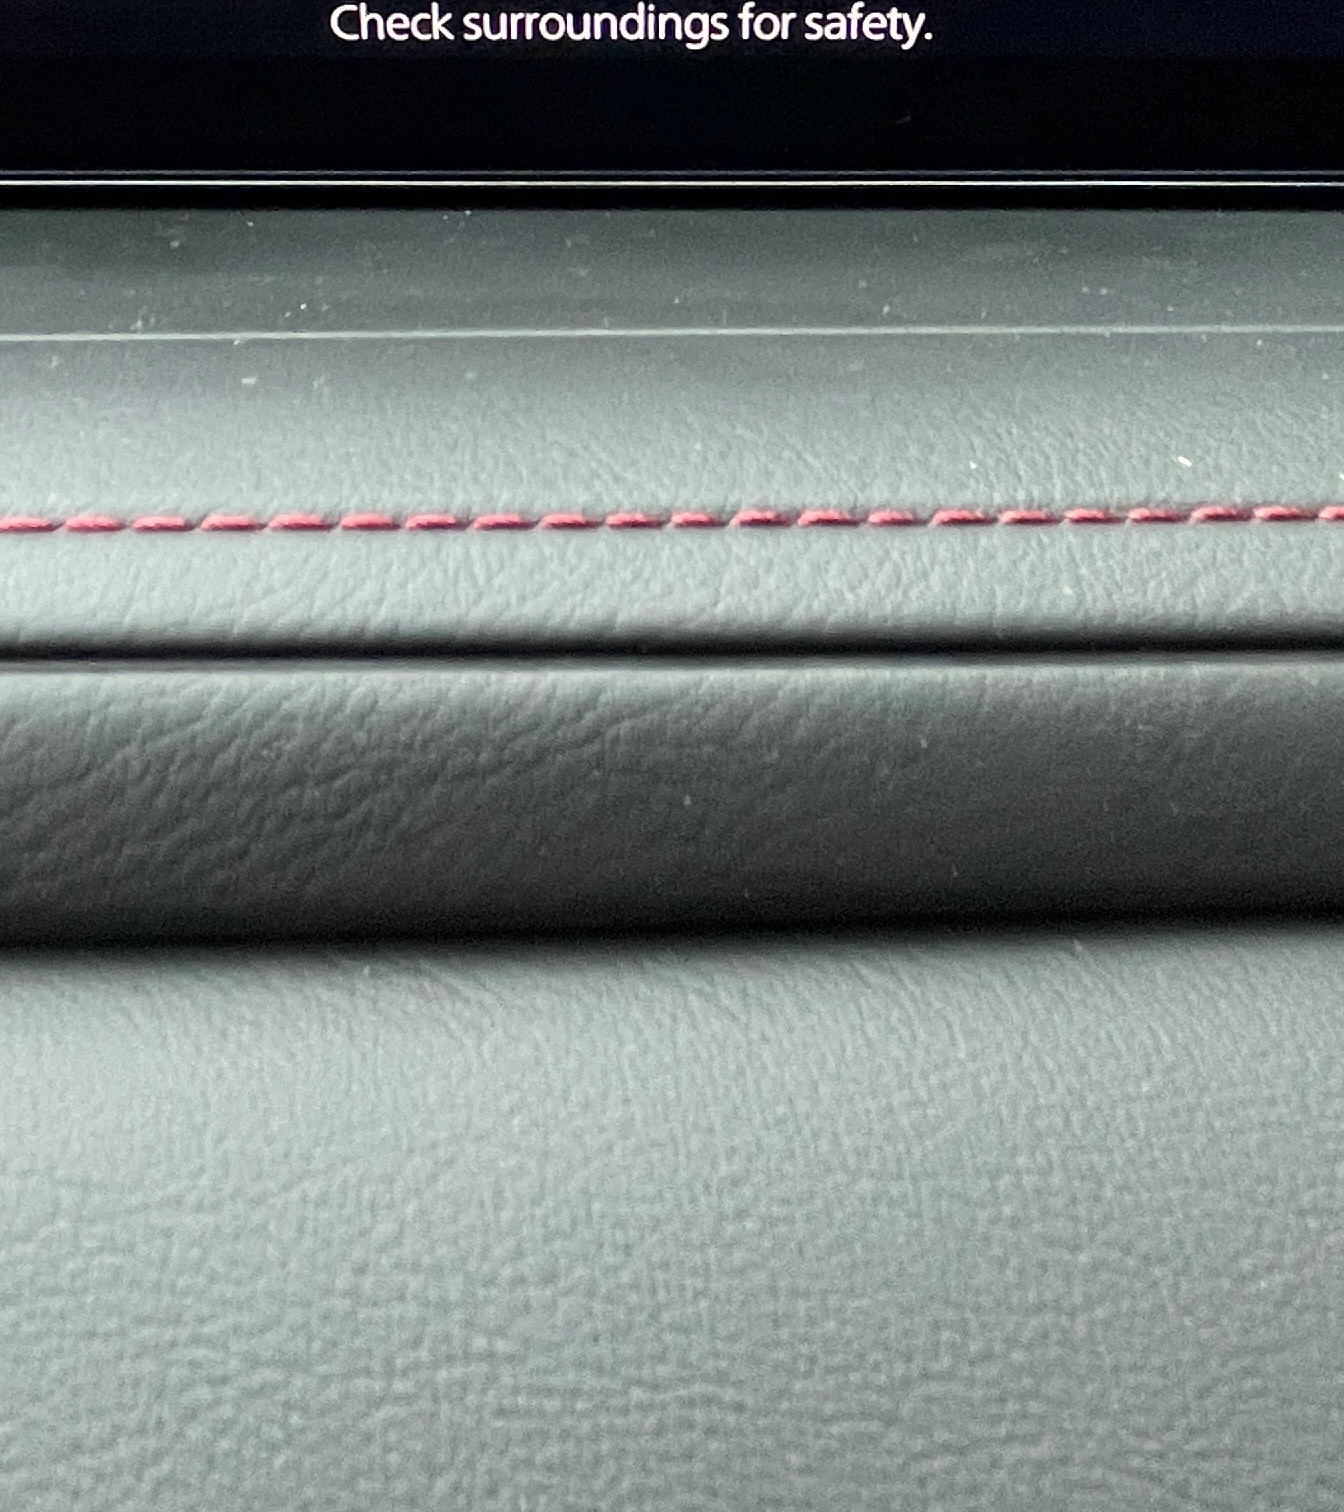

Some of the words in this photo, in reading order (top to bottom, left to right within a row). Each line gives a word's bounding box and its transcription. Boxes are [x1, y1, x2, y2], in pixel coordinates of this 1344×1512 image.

[330, 1, 454, 40] Check
[462, 1, 729, 49] surroundings
[737, 1, 797, 40] for
[804, 1, 932, 49] safety.
